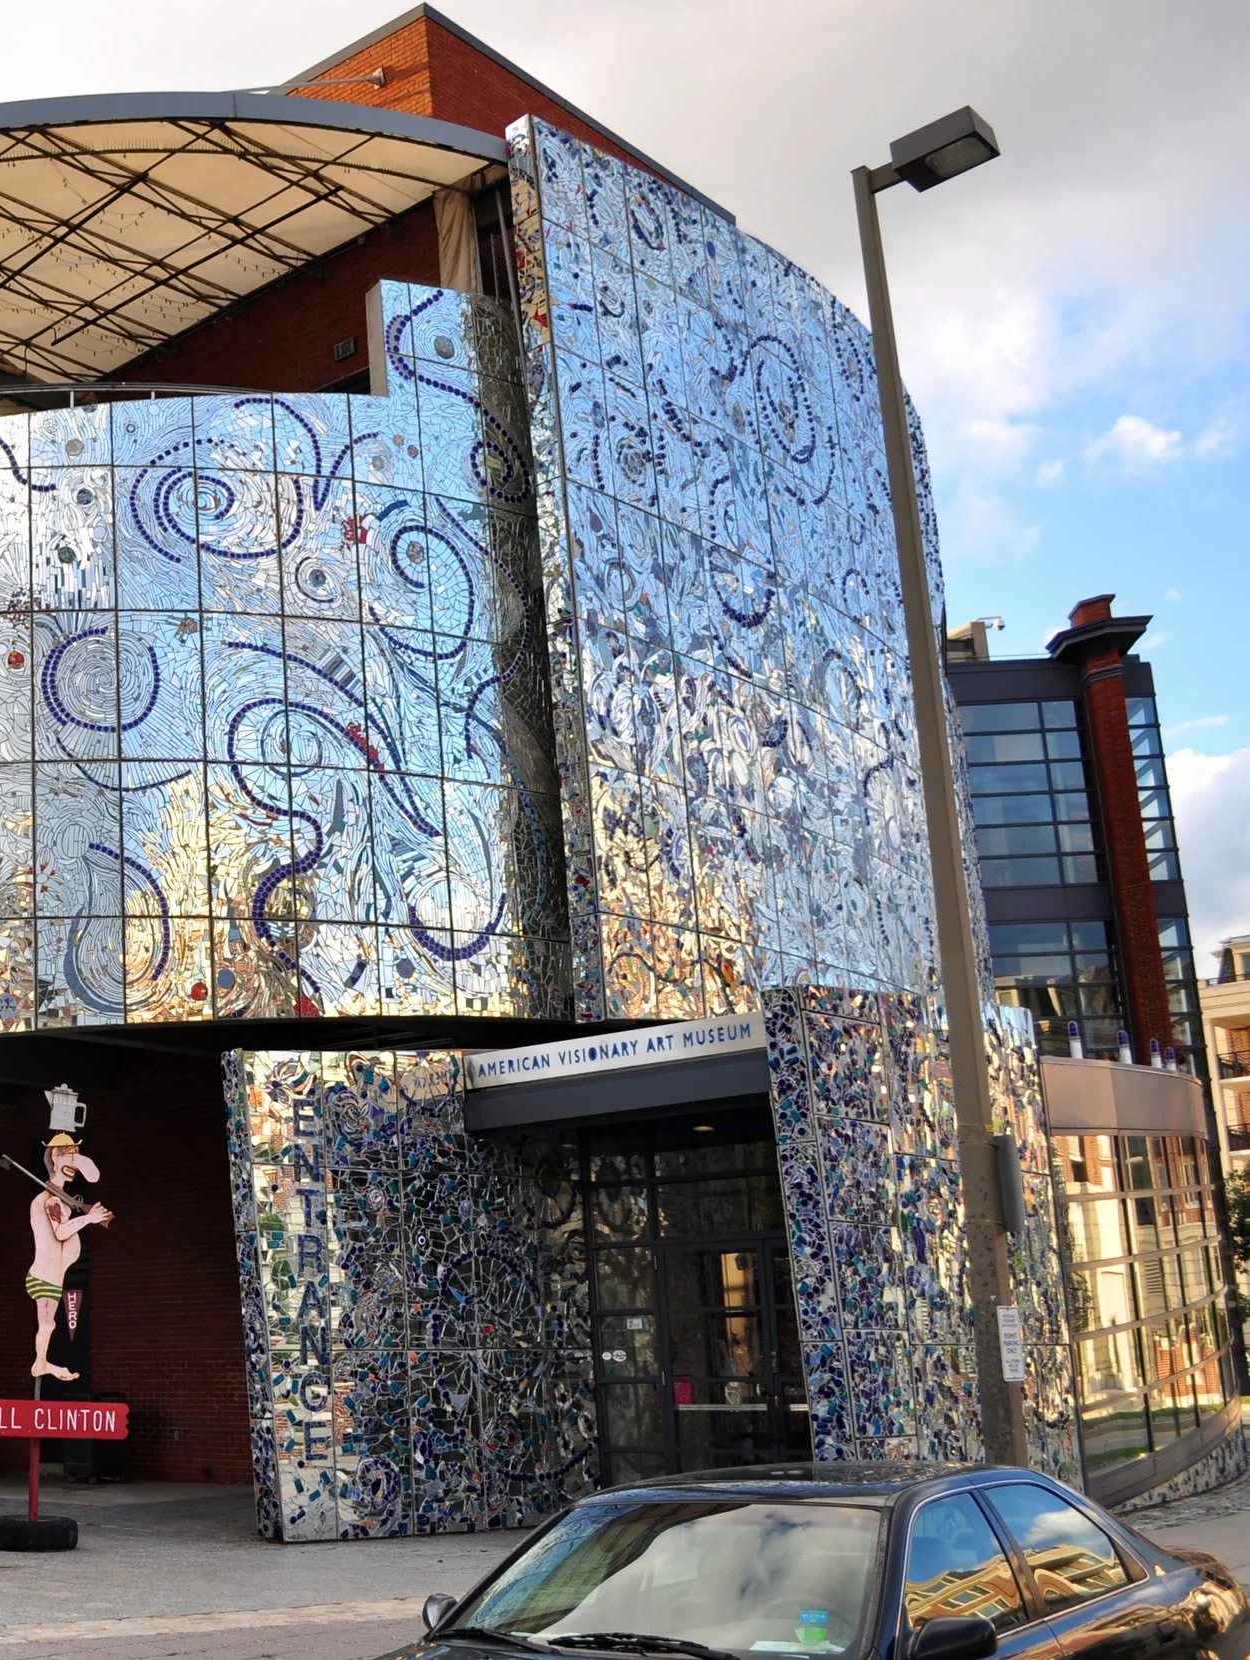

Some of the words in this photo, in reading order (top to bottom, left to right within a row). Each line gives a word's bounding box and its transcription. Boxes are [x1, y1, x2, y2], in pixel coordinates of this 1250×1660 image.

[478, 1053, 551, 1078] AMERICAN
[558, 1040, 638, 1066] VISIONARY
[646, 1034, 674, 1054] ART
[683, 1023, 751, 1048] MUSEUM
[293, 1099, 330, 1461] ENTRANCE
[67, 1292, 78, 1330] HERO
[34, 1408, 116, 1432] CLINTON
